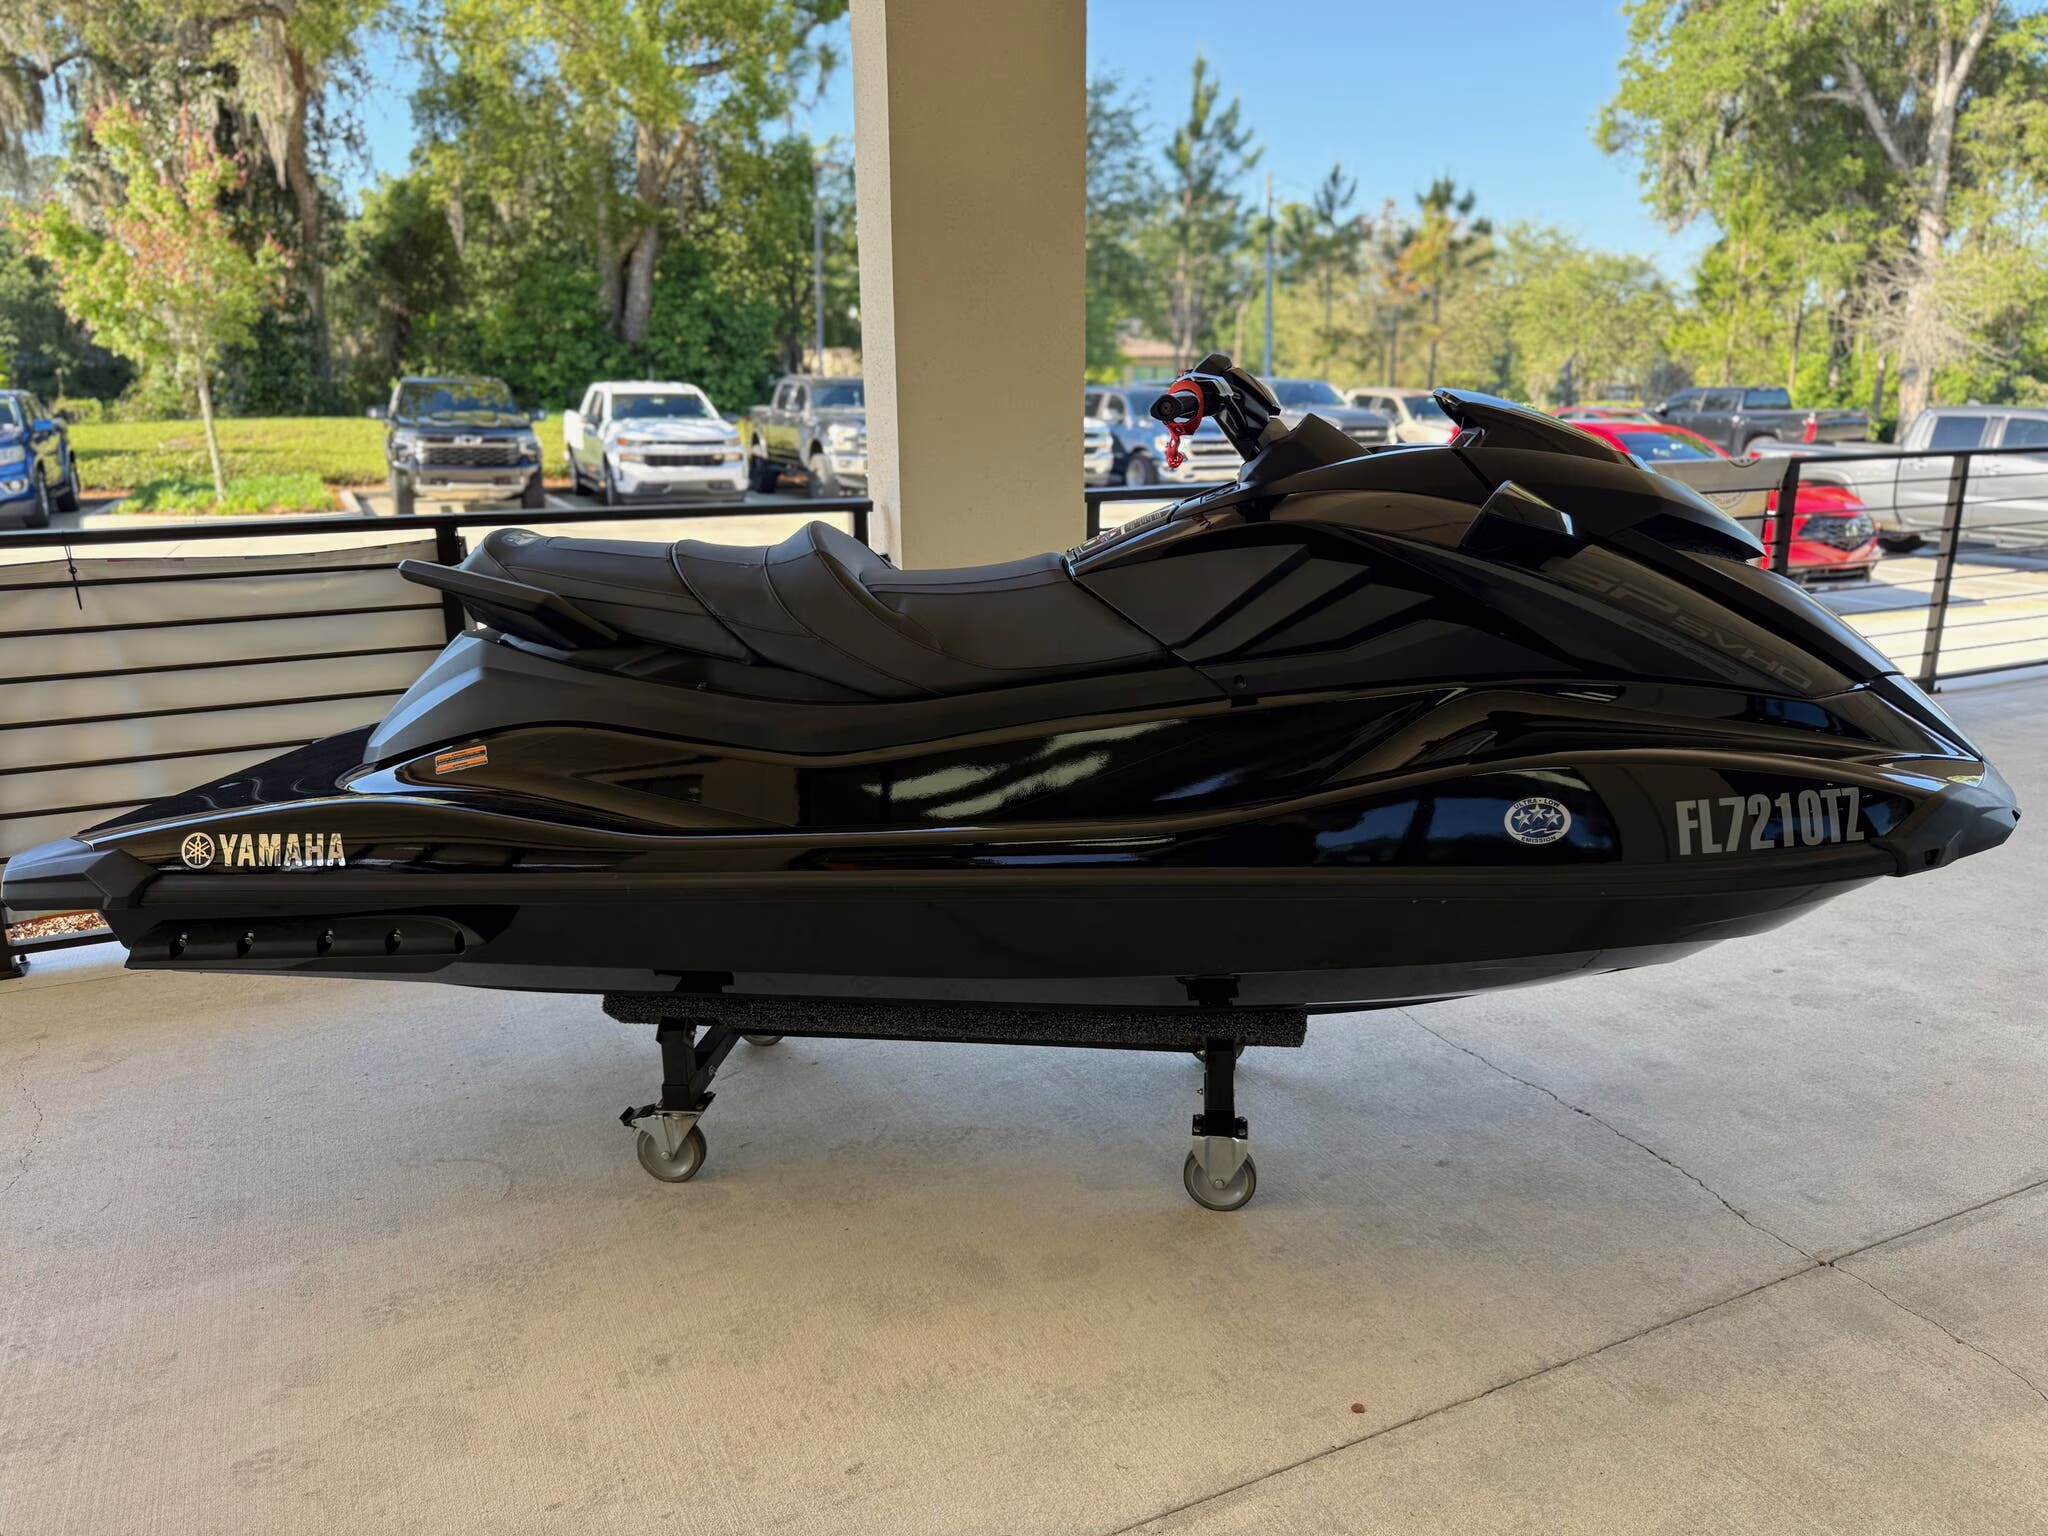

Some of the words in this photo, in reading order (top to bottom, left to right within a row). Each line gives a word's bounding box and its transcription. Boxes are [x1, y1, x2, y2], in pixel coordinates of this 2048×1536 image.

[1671, 615, 1812, 690] SVHO
[218, 833, 347, 867] YAMAHA
[1675, 787, 1865, 856] FL7210TZ
